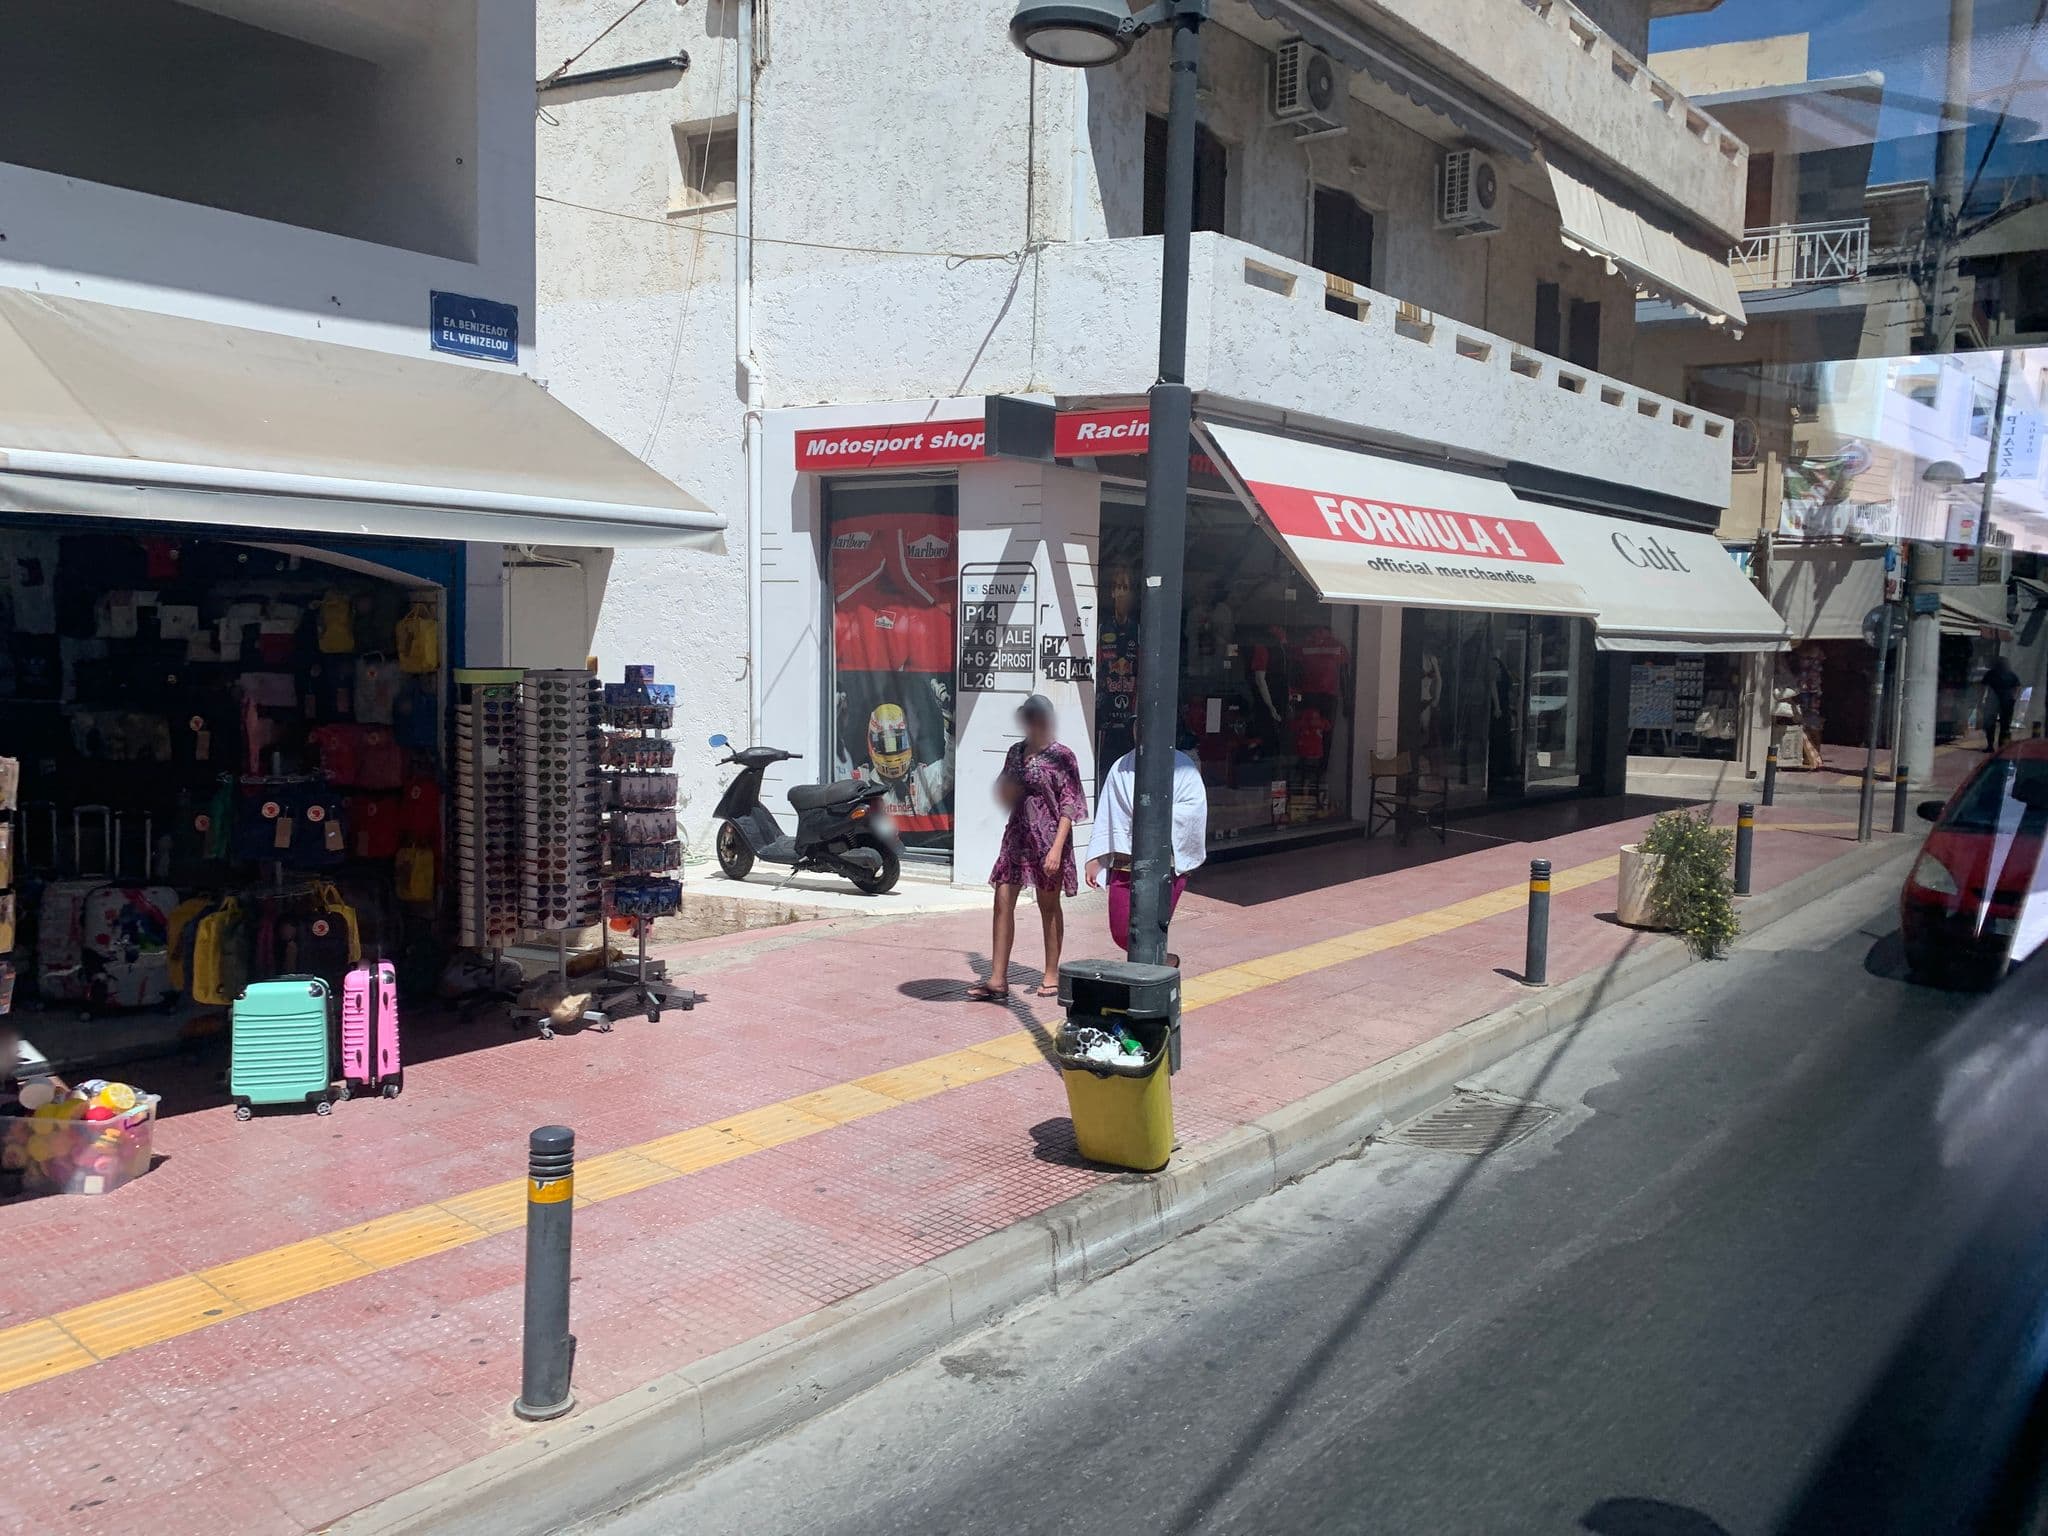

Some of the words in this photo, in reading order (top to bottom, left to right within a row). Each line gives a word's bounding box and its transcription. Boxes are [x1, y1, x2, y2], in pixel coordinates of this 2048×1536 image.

[806, 434, 923, 456] Motosport
[929, 431, 985, 450] shop
[1312, 496, 1502, 556] FORMULA
[1496, 521, 1527, 557] 1
[1611, 532, 1691, 573] Cult
[1368, 557, 1433, 576] official
[1435, 564, 1536, 585] merchandise
[982, 584, 1016, 595] SENNA
[966, 605, 996, 621] P14
[1005, 630, 1030, 644] ALE
[1002, 653, 1031, 668] PROST
